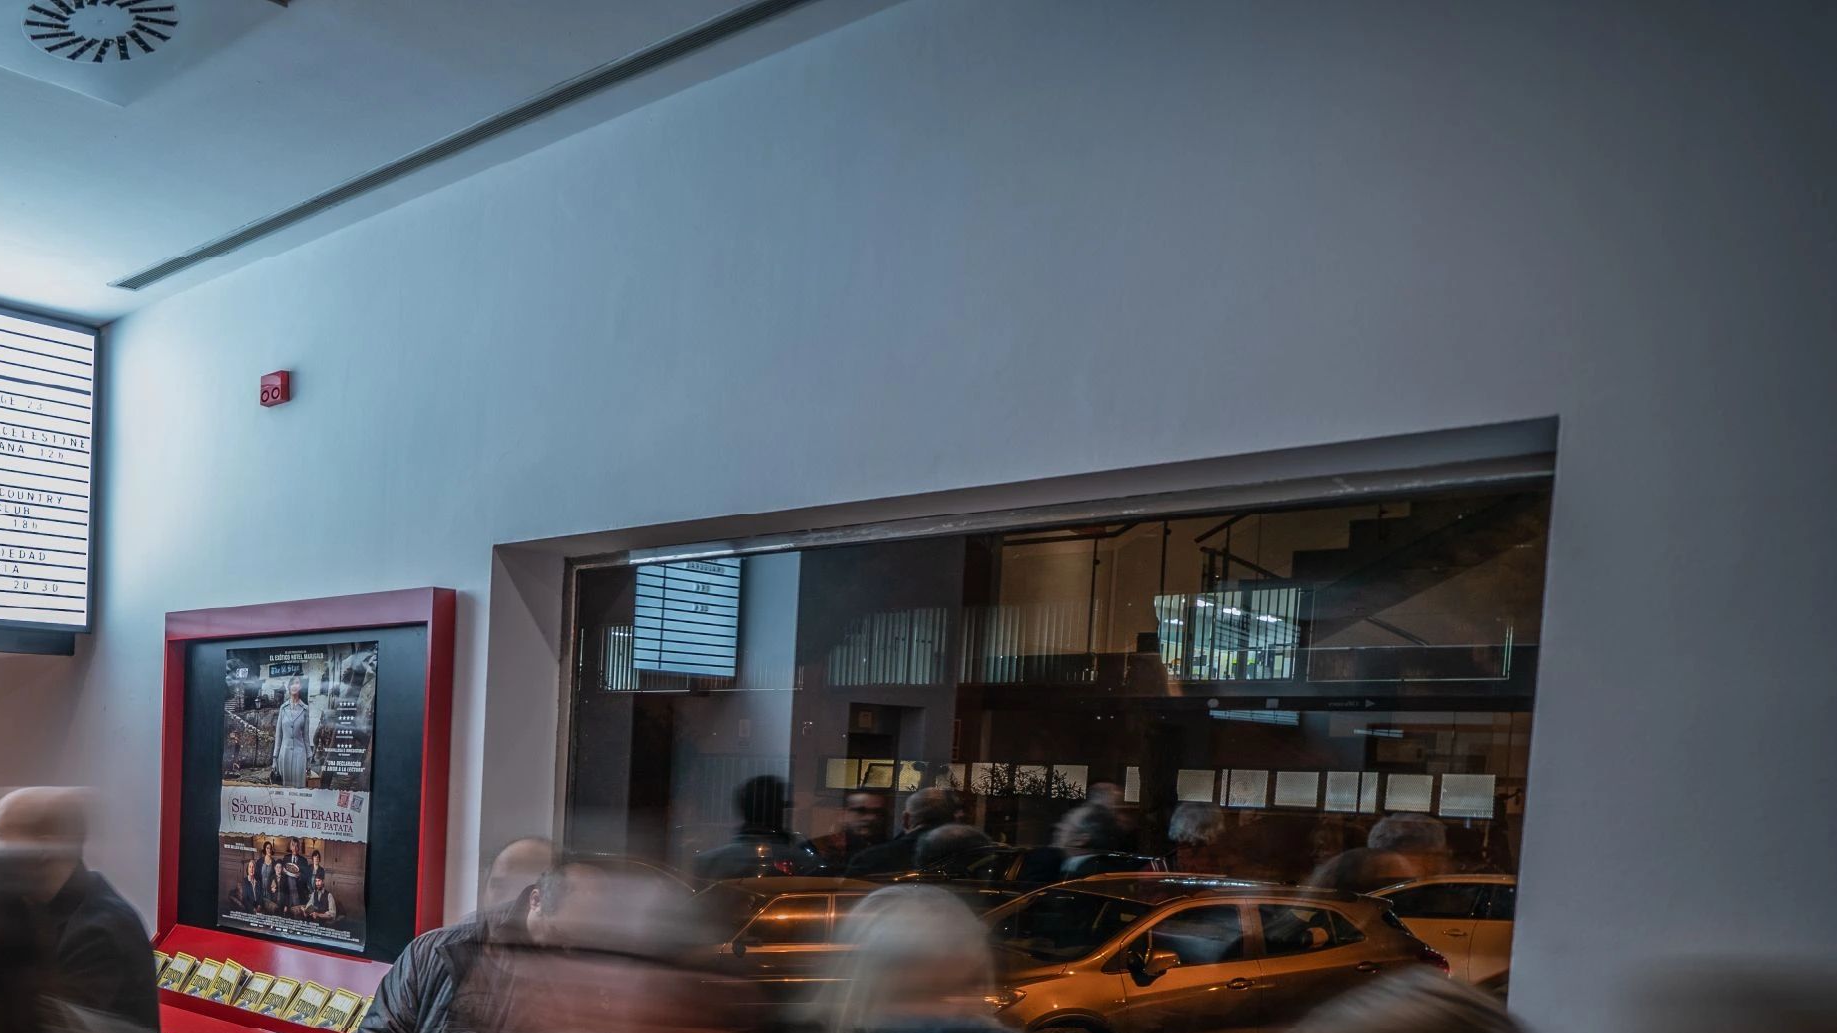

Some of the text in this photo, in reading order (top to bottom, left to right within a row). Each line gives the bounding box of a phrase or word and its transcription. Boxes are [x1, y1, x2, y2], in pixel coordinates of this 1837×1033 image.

[238, 795, 248, 803] LA
[239, 814, 248, 822] EL
[249, 815, 277, 825] PASTEL
[278, 818, 289, 826] DE
[291, 819, 309, 828] PIEL
[323, 823, 354, 833] PATATA
[294, 998, 319, 1019] EDISON
[322, 1005, 348, 1026] EDISON
